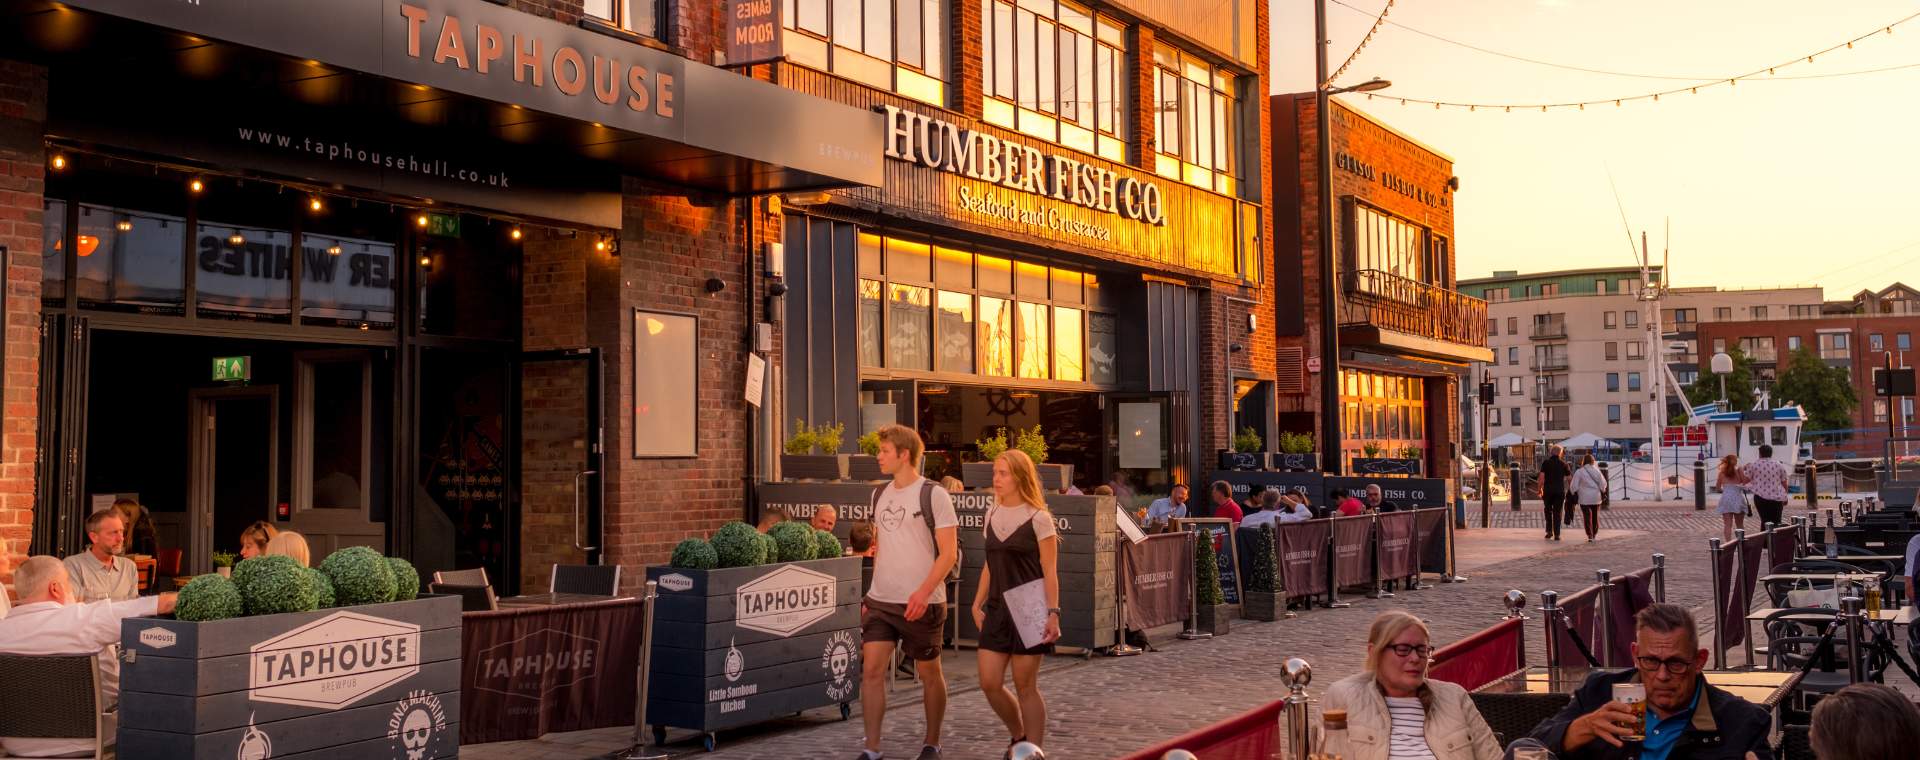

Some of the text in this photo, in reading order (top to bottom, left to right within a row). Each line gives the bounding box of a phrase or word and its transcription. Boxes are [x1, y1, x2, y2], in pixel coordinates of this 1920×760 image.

[402, 4, 674, 118] TAPHOUSE
[238, 127, 510, 188] www.taphousehull.co.uk
[884, 104, 1168, 226] HUMBER FISH CO.
[959, 185, 1111, 242] Seafood and Crustacea
[1384, 489, 1406, 499] FISH
[662, 578, 690, 587] TAPHOUSE
[744, 585, 829, 614] TAPHOUSE
[142, 633, 174, 643] TAPHOUSE
[264, 637, 407, 683] TAPHOUSE
[484, 649, 593, 679] TAPHOUSE
[321, 678, 357, 693] BREWPUB
[709, 688, 727, 702] Little
[826, 684, 845, 701] BREW
[387, 689, 446, 740] BONE MACHINE
[720, 699, 746, 713] Kitchen
